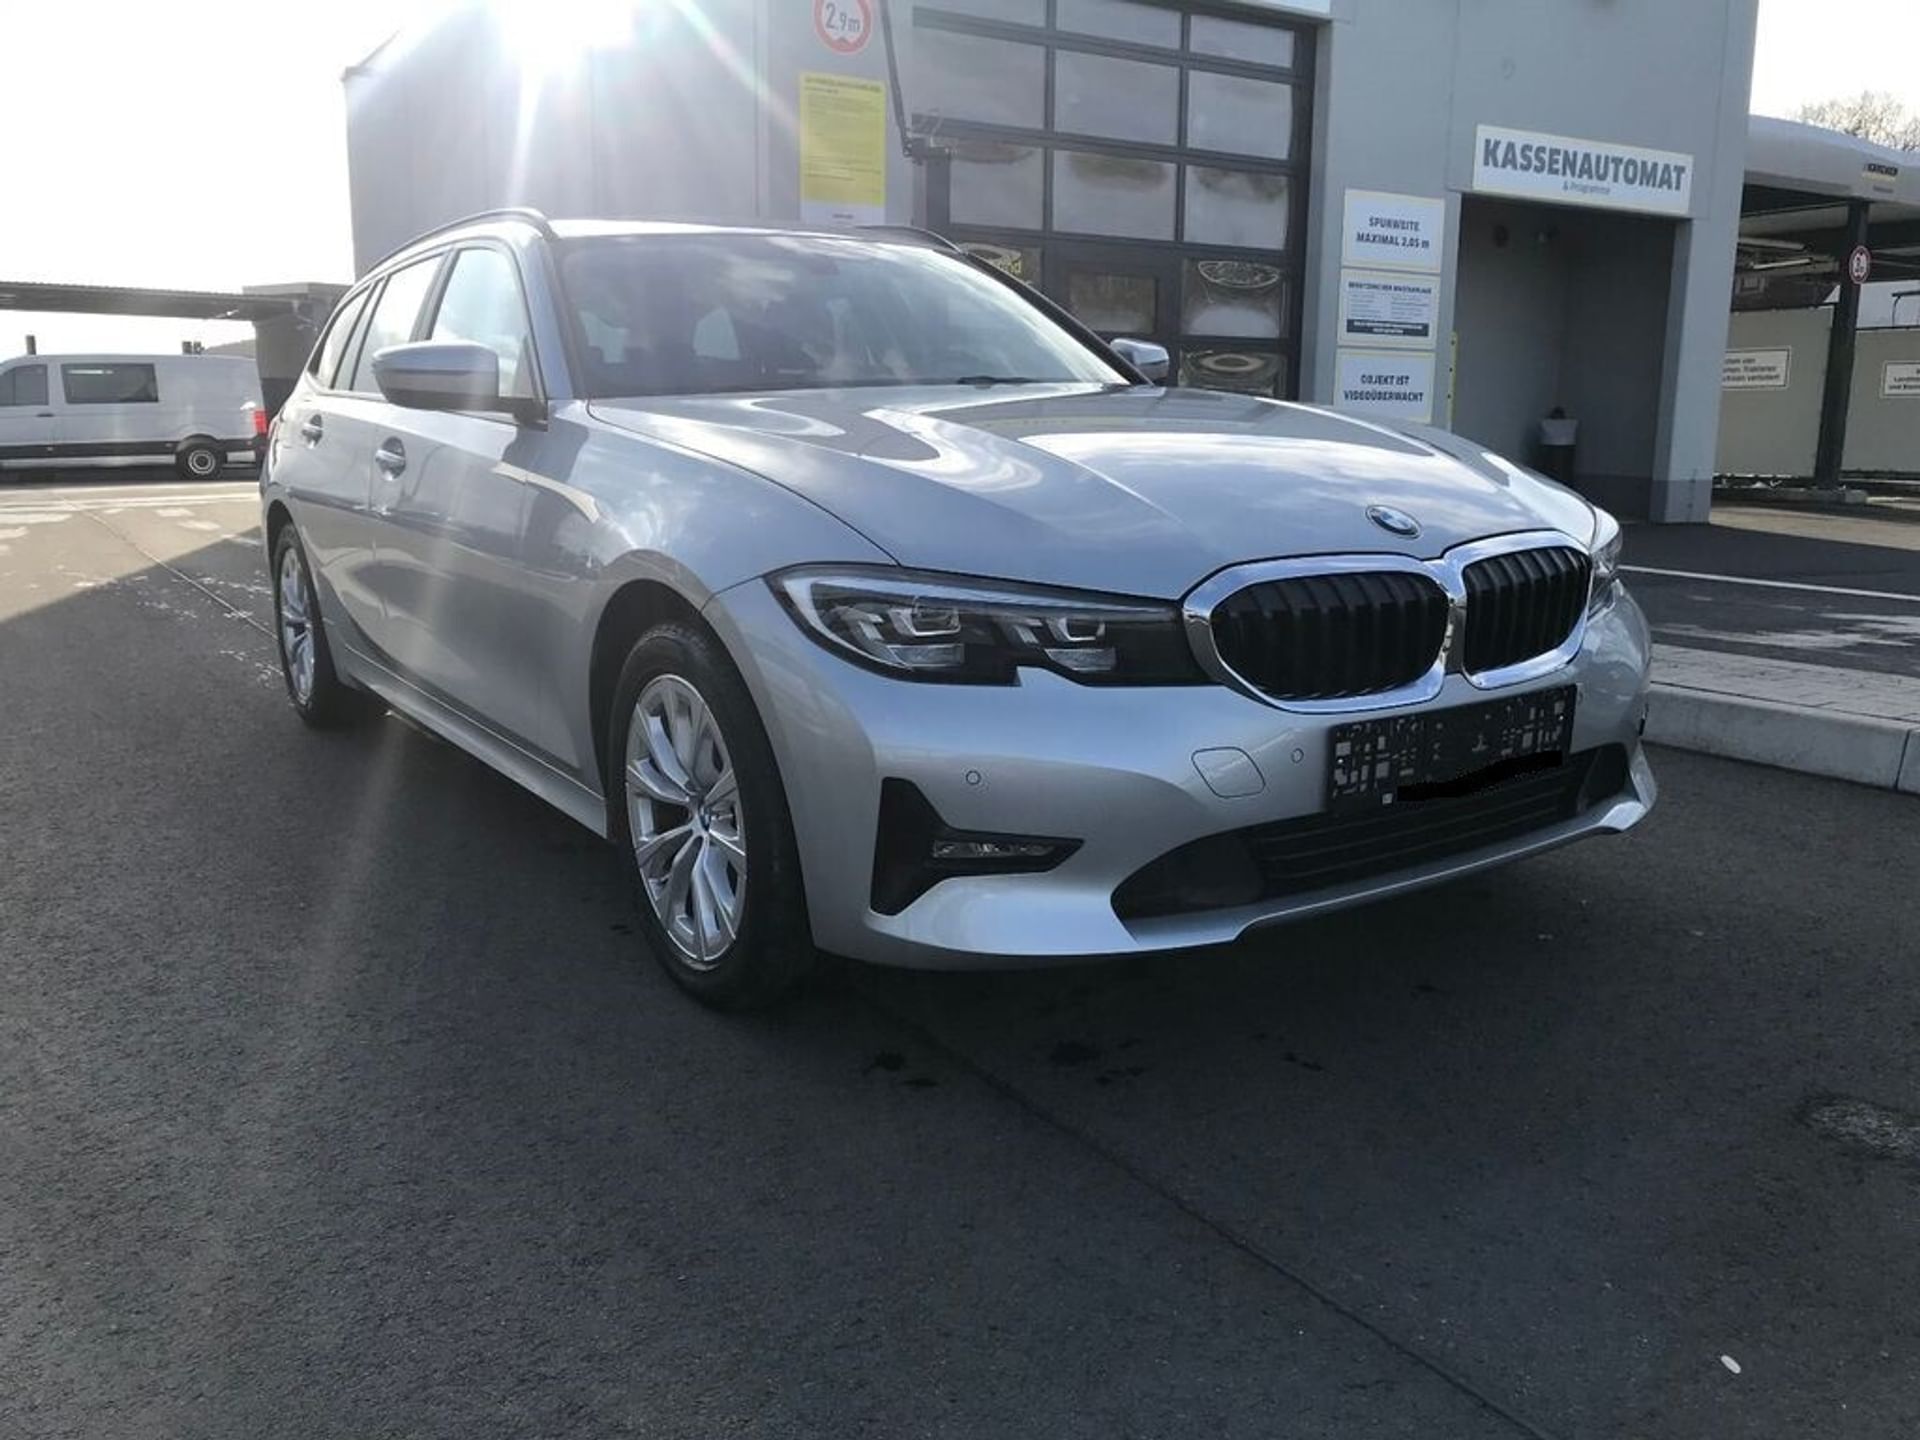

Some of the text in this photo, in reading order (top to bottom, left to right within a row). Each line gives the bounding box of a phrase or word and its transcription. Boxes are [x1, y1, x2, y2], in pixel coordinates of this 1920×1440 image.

[1483, 138, 1686, 191] KASSENAUTOMAT
[1368, 216, 1420, 231] SPURWEITE
[1356, 231, 1400, 246] MAXIMAL
[1361, 374, 1395, 385] OBJEKT
[1343, 387, 1424, 402] VIDEOÜBERWACHT
